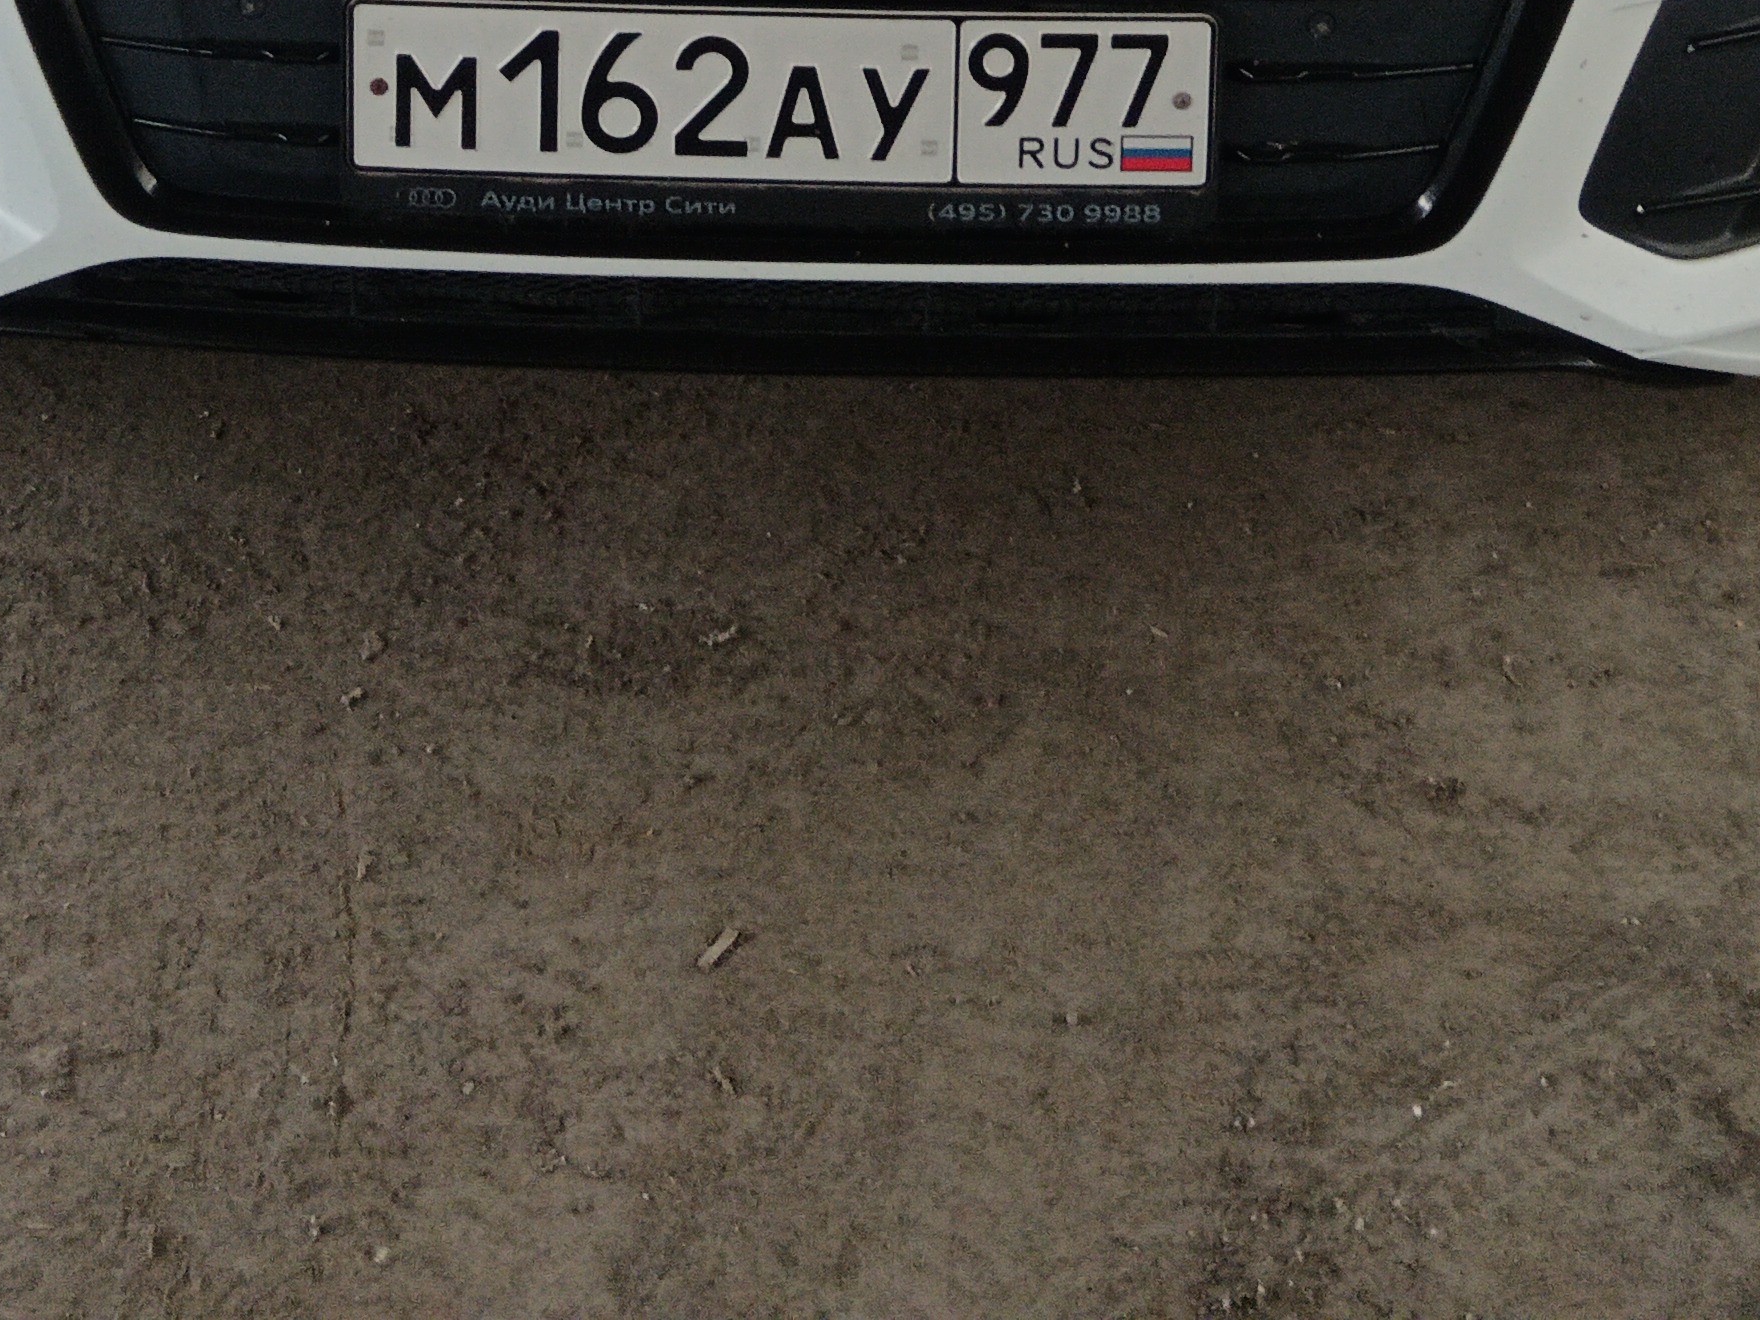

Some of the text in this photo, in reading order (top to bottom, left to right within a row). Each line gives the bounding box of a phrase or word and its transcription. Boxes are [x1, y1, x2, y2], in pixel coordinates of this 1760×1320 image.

[395, 30, 1169, 161] М162АУ 977
[1018, 136, 1115, 169] RUS
[481, 191, 736, 216] Ауди Центр Сити
[928, 203, 1162, 224] (495) 730 9988
